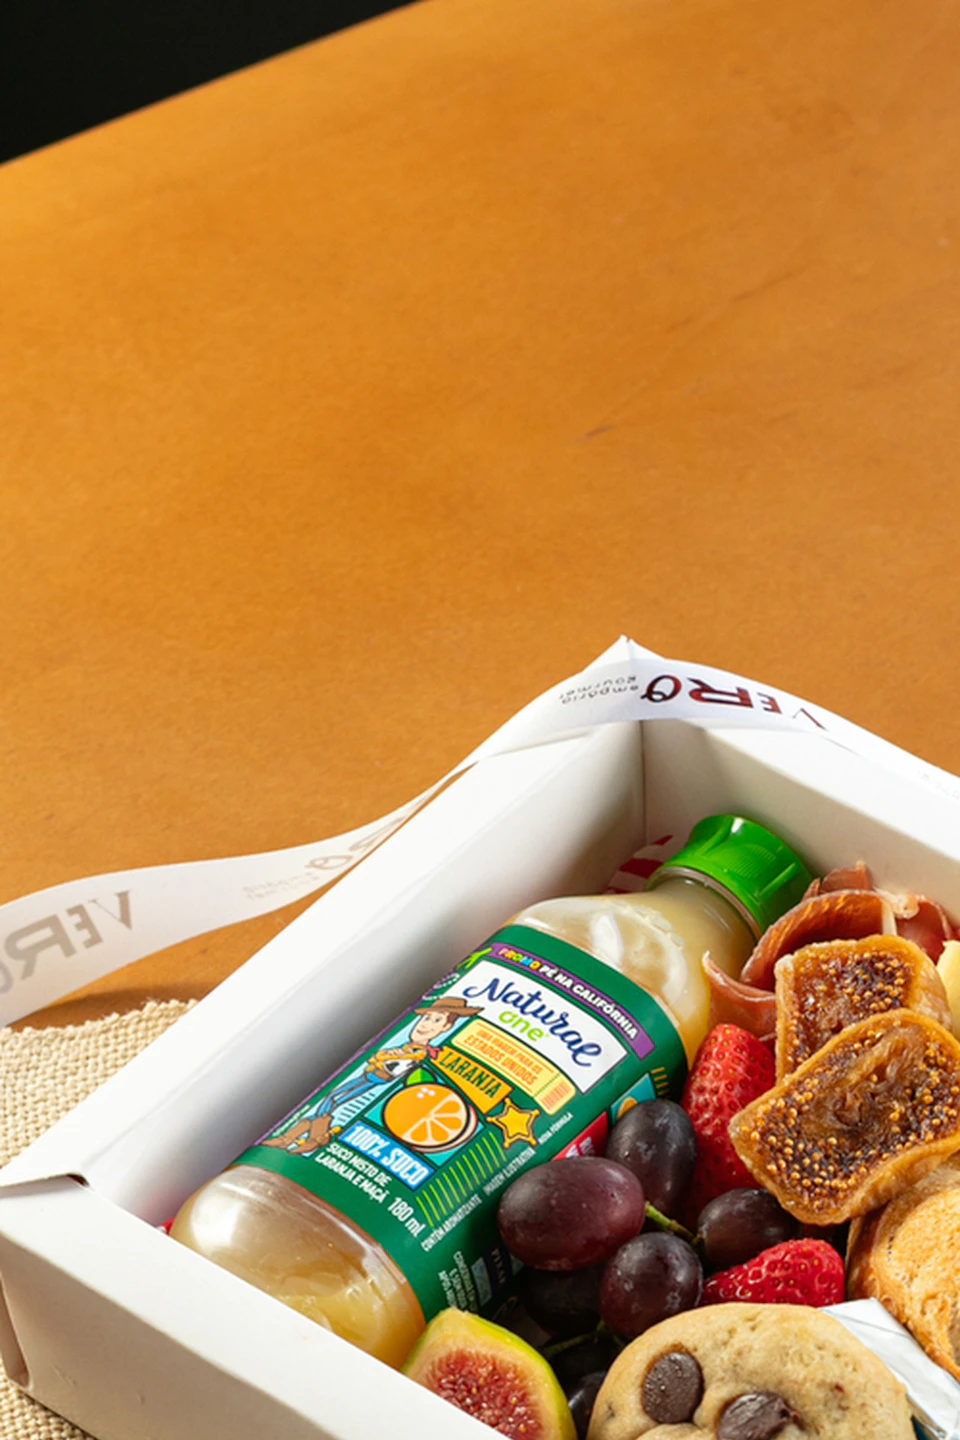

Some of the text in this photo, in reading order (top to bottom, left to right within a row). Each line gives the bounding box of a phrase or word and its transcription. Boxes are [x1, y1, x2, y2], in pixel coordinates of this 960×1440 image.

[641, 675, 827, 731] VERO
[499, 948, 639, 1040] PROMO PÉ NA CALIFÓRNIA
[462, 978, 602, 1067] Natural
[498, 1010, 545, 1042] one
[438, 1051, 502, 1098] LARANJA
[464, 1034, 538, 1086] ESTADOS UNIDOS
[315, 1152, 390, 1204] LARANJA E MAÇÃ
[326, 1142, 392, 1187] SUCO MISTO DE
[344, 1125, 429, 1186] 100% SUCO
[387, 1197, 414, 1222] 180
